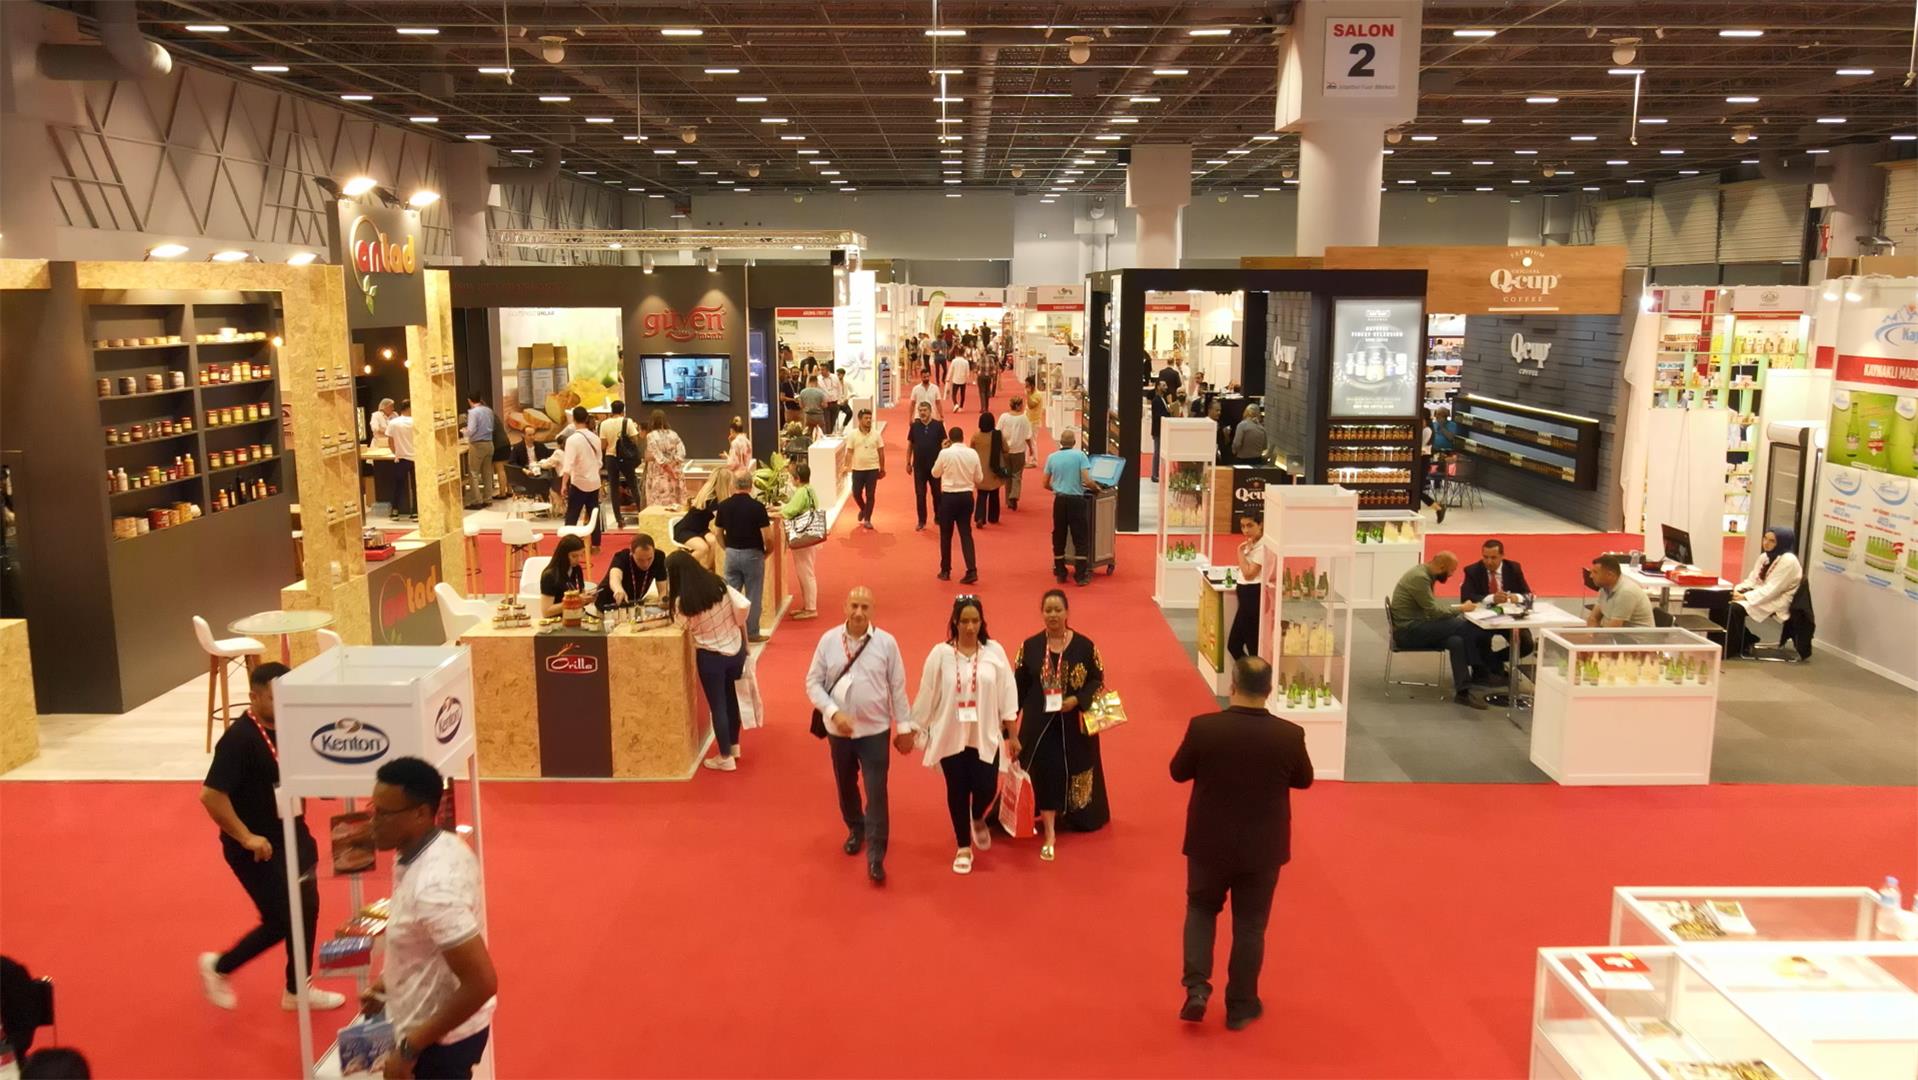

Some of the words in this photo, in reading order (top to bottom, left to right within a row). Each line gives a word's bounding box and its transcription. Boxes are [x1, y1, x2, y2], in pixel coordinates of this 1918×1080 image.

[1333, 24, 1395, 38] SALON
[1347, 42, 1376, 78] 2
[1863, 363, 1898, 379] KAYNAKLI
[551, 657, 593, 670] Orilla
[438, 709, 460, 733] Kenton
[321, 734, 381, 752] Kenton
